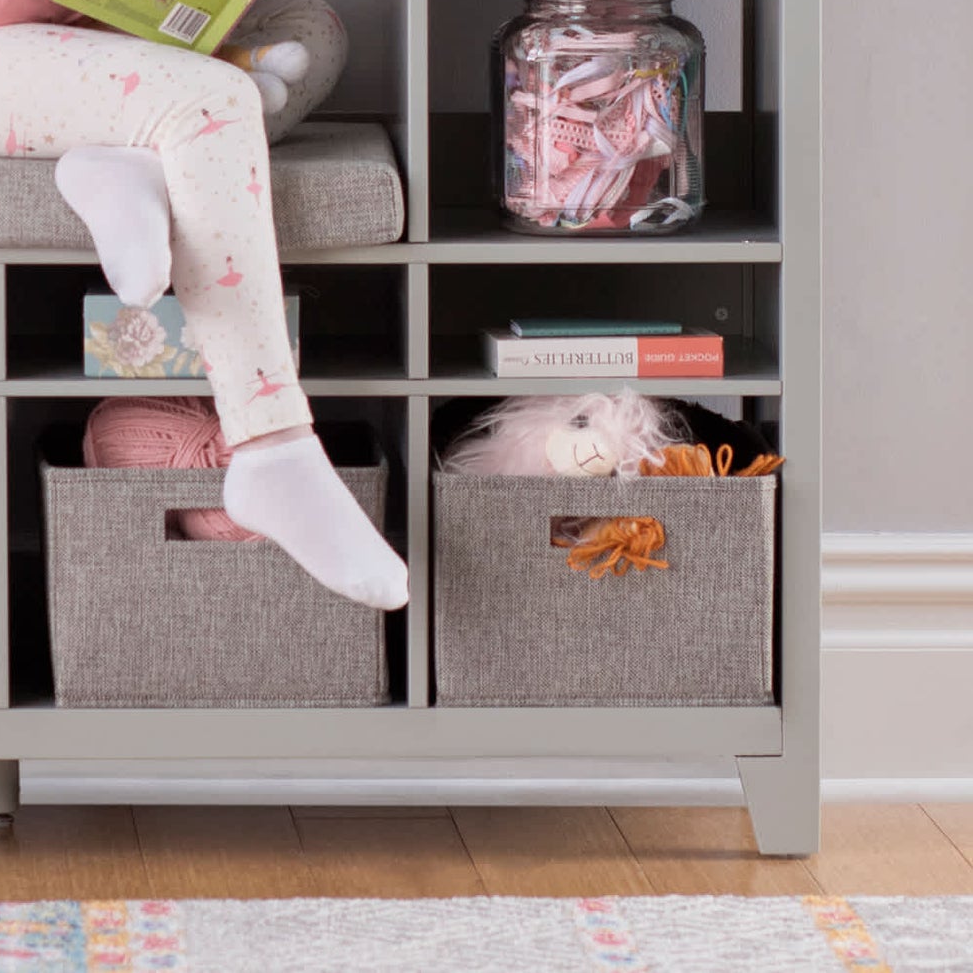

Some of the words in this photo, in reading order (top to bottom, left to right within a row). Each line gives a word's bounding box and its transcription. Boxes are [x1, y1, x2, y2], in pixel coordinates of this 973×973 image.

[533, 352, 634, 366] BUTTERFLIES
[644, 353, 675, 363] GUIDE
[678, 353, 719, 363] POCKET
